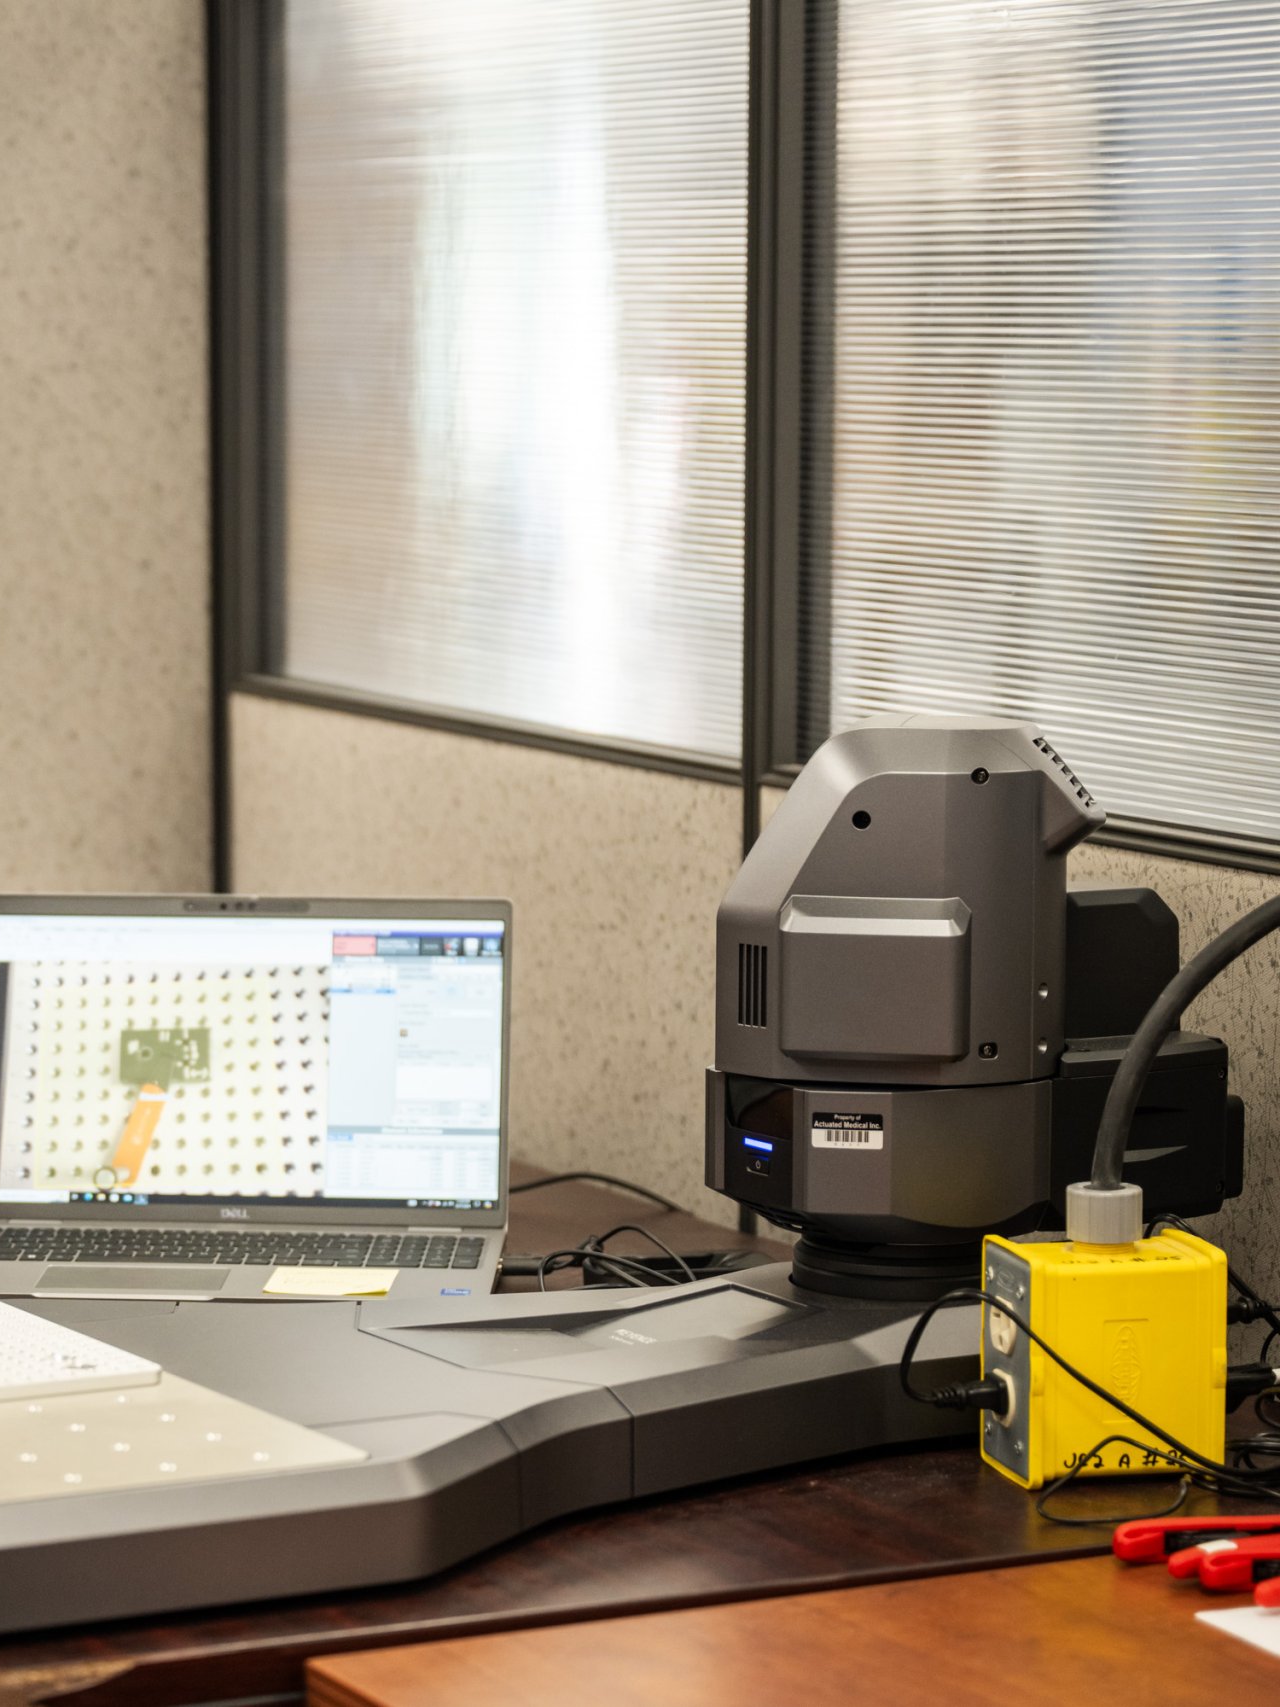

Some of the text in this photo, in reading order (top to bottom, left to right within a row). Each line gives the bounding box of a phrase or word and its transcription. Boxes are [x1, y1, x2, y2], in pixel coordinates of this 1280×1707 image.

[814, 1120, 842, 1128] Actuated
[843, 1121, 868, 1129] Medical
[1118, 1453, 1130, 1468] A
